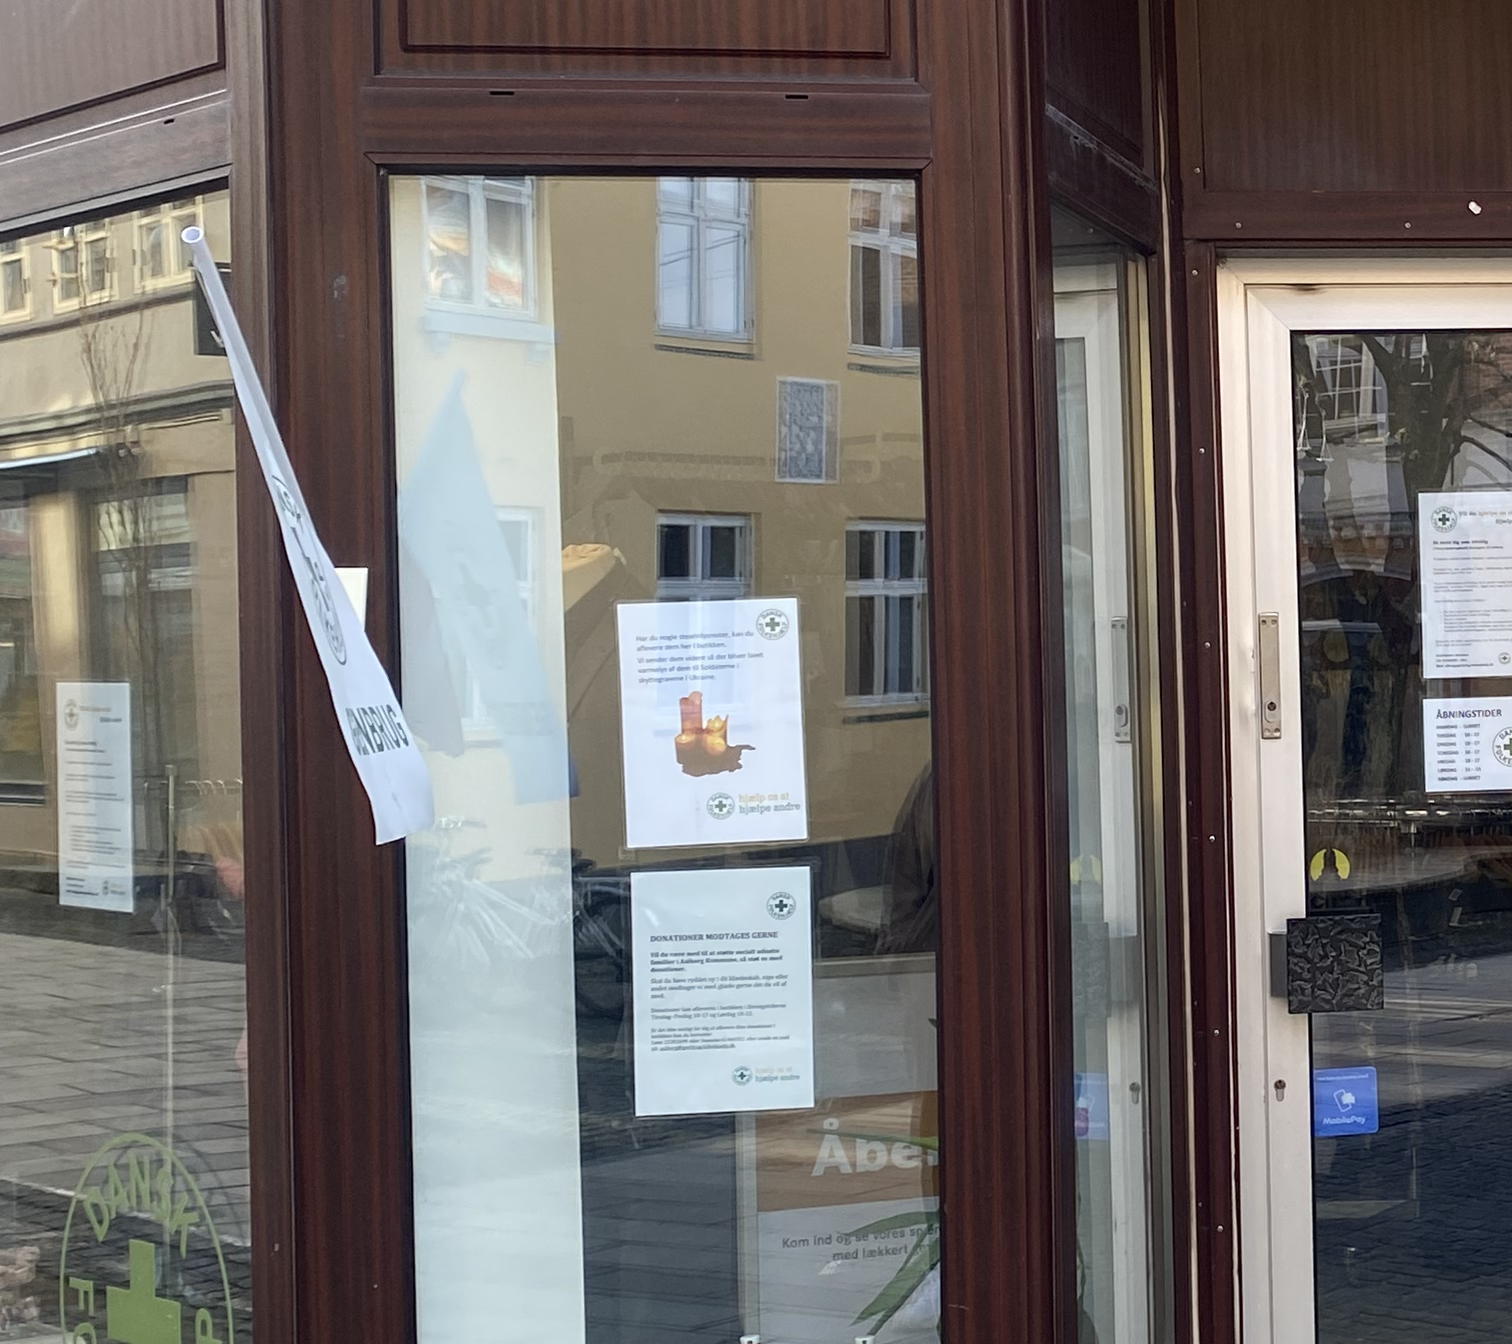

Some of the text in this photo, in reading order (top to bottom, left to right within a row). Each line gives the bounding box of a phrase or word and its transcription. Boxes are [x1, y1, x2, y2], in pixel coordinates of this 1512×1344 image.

[1436, 709, 1502, 719] ÅBNINGSTIDER
[774, 802, 801, 811] andre
[650, 934, 704, 942] DONATIONER
[706, 932, 750, 940] MODTAGES
[1323, 1116, 1366, 1124] MobilePay
[811, 1118, 939, 1177] Åbe
[84, 1153, 199, 1259] DANSK
[782, 1230, 905, 1248] Kom ind og se vores
[833, 1249, 858, 1260] med
[863, 1244, 908, 1258] lækkert
